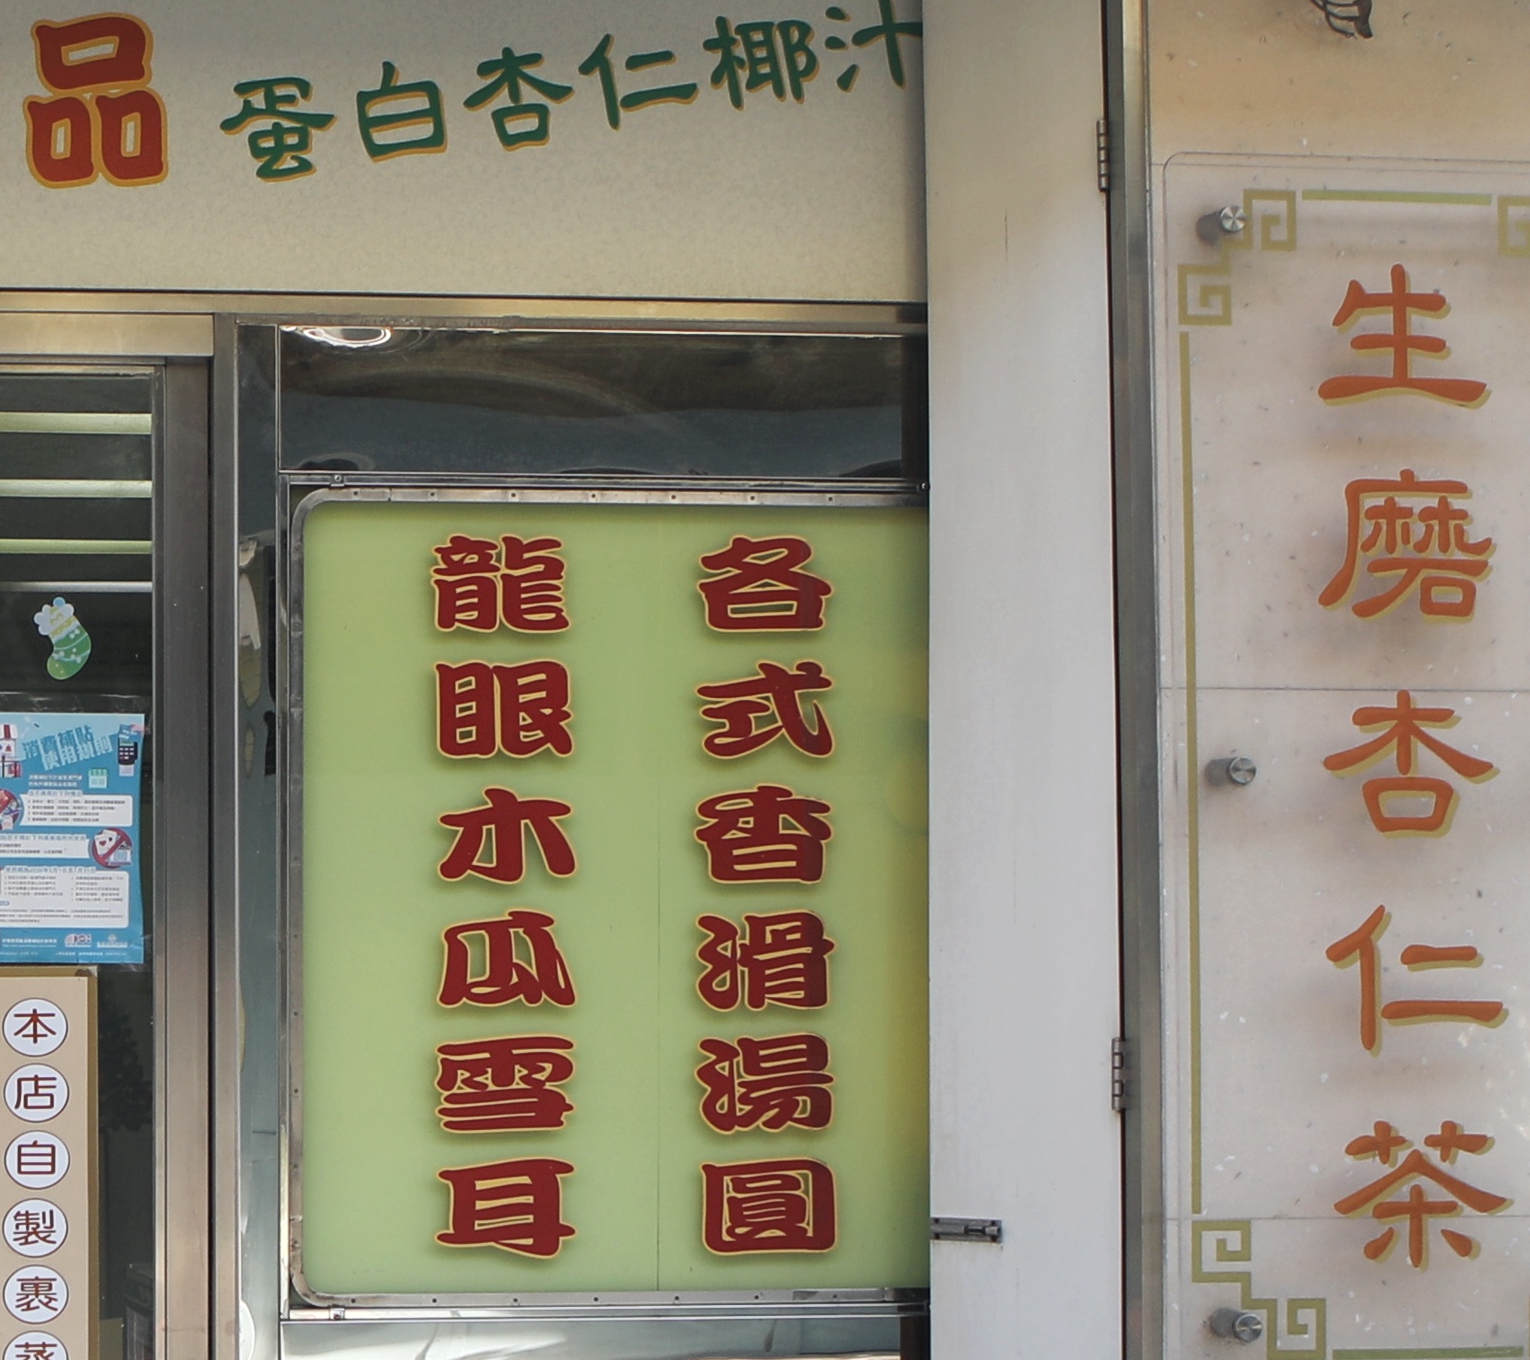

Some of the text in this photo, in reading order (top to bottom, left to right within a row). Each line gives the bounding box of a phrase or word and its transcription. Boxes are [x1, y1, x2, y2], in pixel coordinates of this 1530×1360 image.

[429, 534, 578, 1259] 龍眼木瓜雪耳
[694, 535, 839, 1256] 各式香滑湯圓
[1317, 263, 1513, 1270] 生磨杏仁茶
